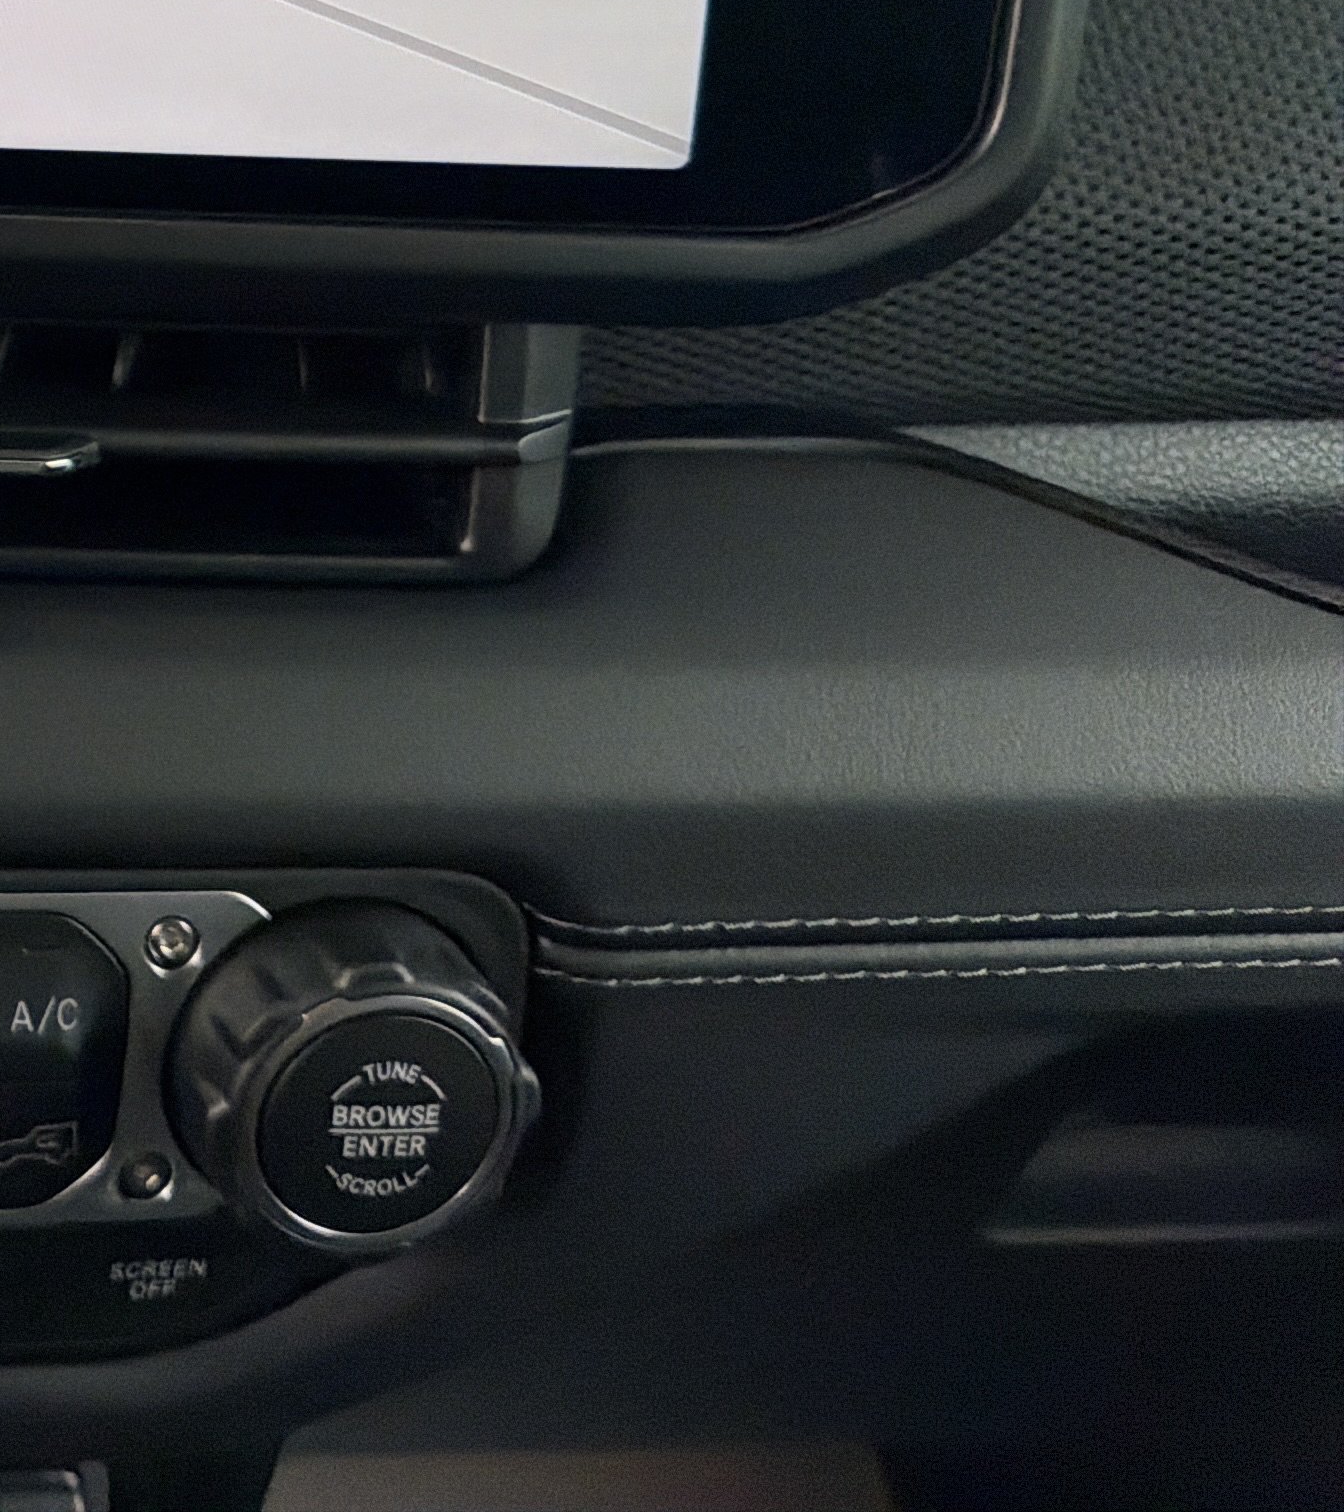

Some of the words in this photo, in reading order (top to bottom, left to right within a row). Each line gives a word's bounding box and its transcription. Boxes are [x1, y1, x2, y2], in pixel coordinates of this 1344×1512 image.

[11, 996, 79, 1034] A/C
[363, 1061, 421, 1085] TUNE
[331, 1104, 440, 1128] BROWSE
[341, 1136, 426, 1158] ENTER
[335, 1171, 417, 1196] SCROLL
[110, 1258, 208, 1280] SCREEN
[129, 1279, 178, 1300] OFF
